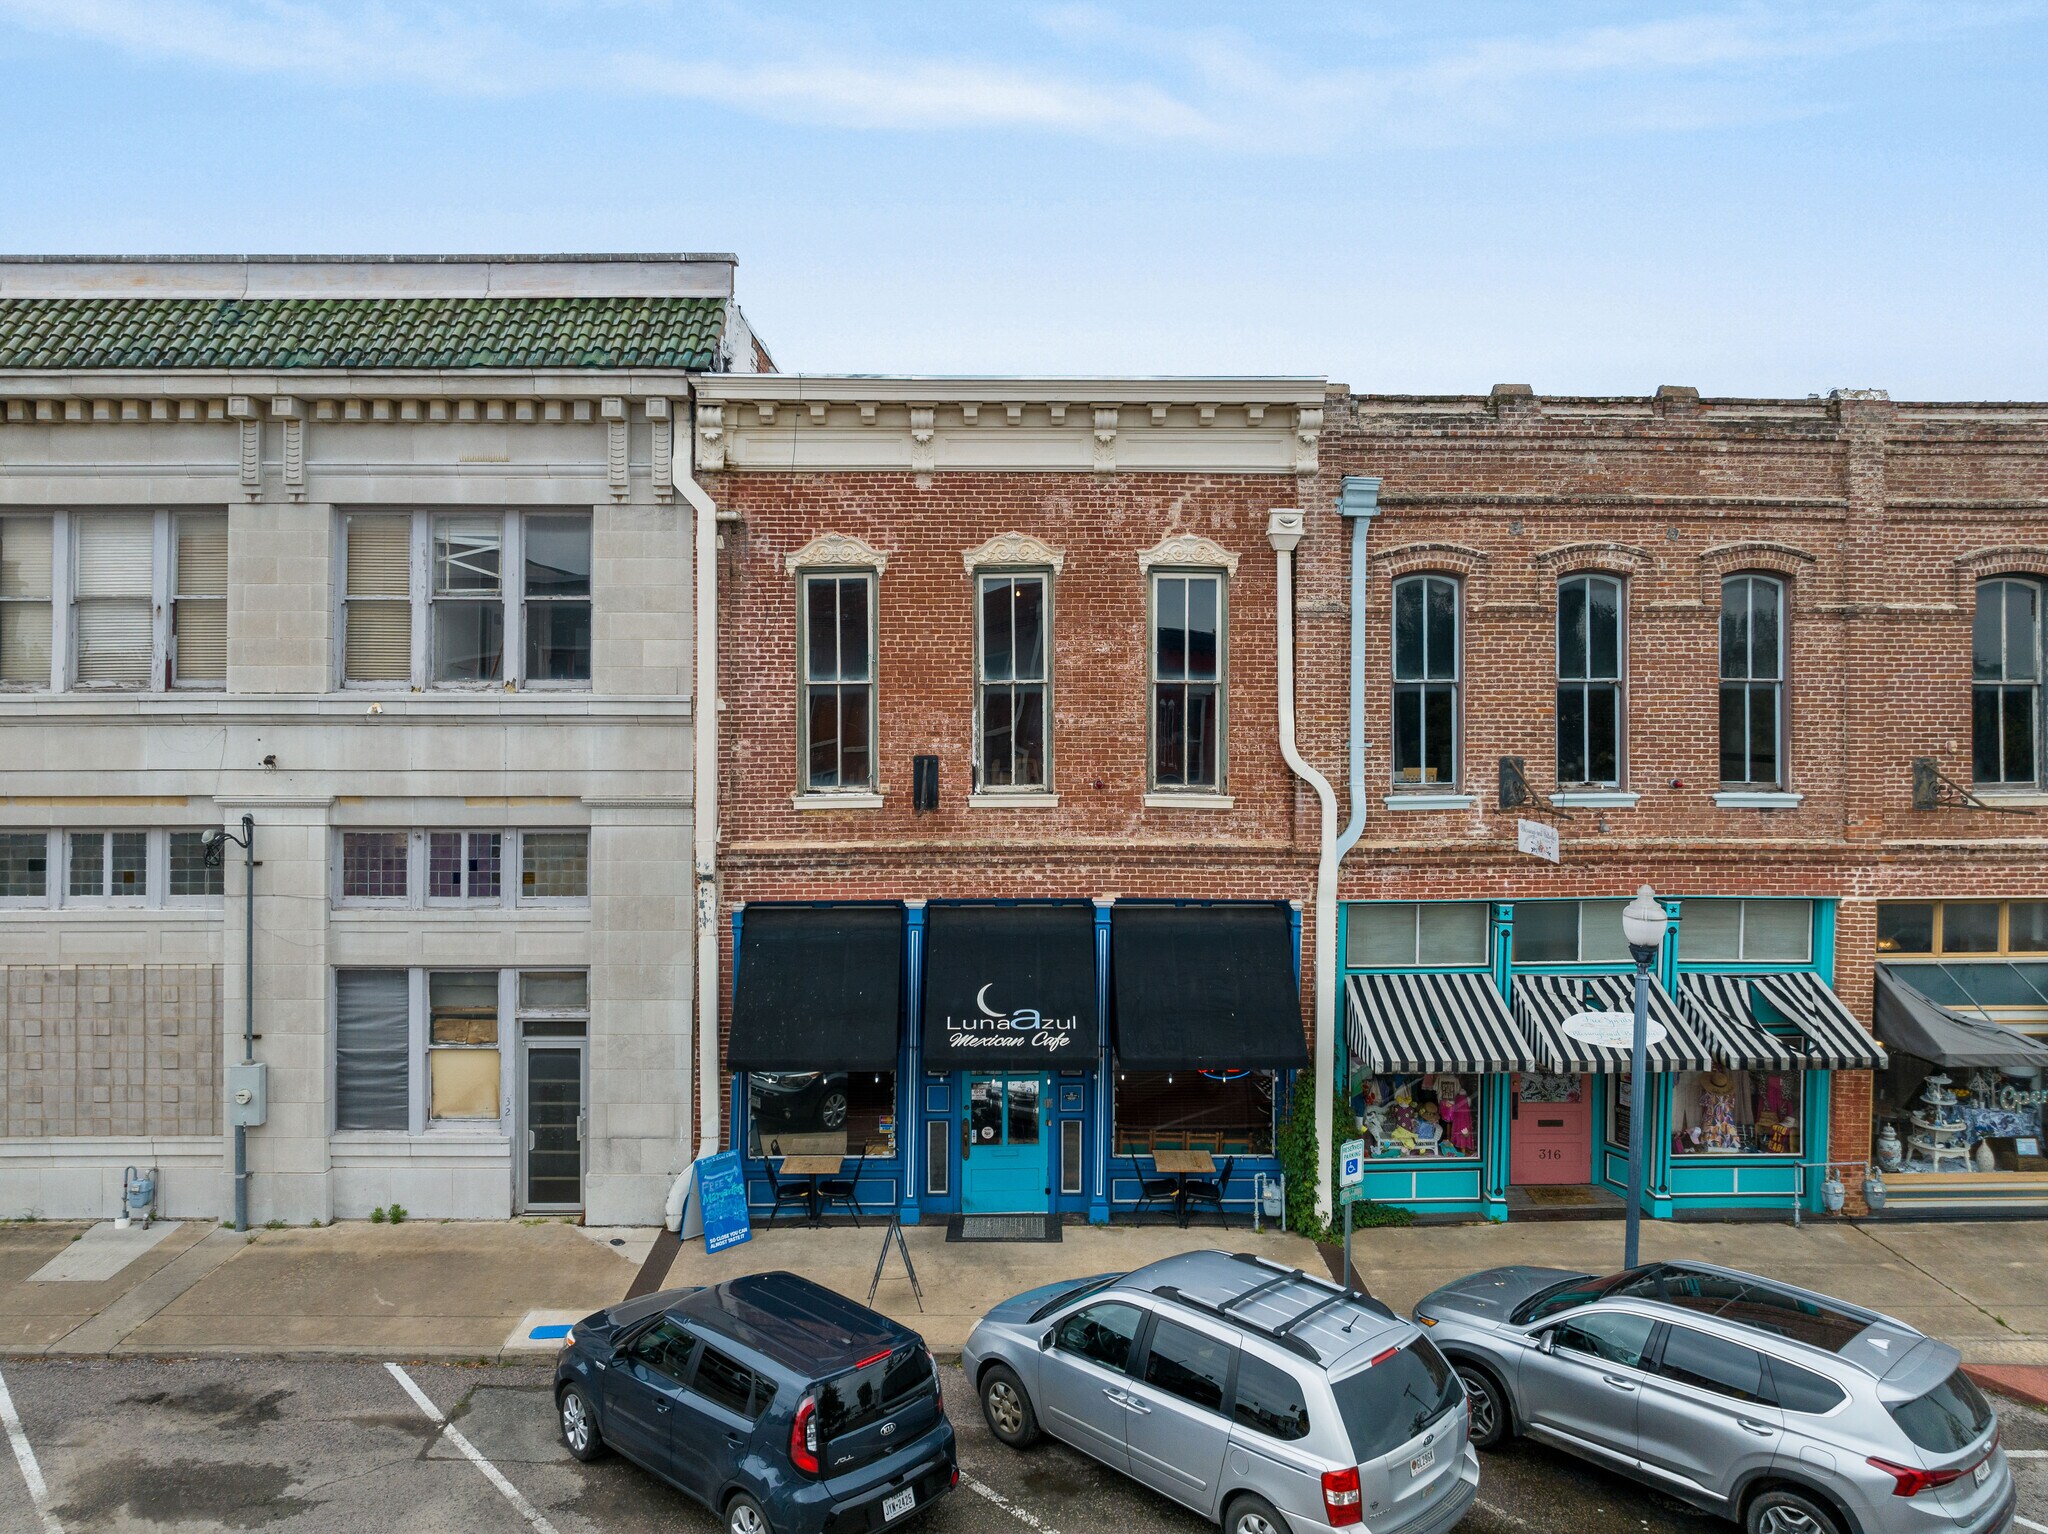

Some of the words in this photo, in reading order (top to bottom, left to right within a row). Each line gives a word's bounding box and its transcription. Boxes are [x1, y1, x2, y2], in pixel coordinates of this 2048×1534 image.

[947, 1016, 1010, 1030] Luna
[949, 1032, 1025, 1048] Mexican
[1031, 1031, 1071, 1052] Cafe
[1342, 1143, 1362, 1153] RESERVED
[1538, 1149, 1562, 1160] 316
[1343, 1151, 1361, 1160] PARKING
[716, 1233, 729, 1241] CLOSE
[730, 1230, 739, 1238] YOU
[738, 1227, 747, 1235] CAN
[710, 1239, 728, 1249] ALMOST
[728, 1234, 740, 1243] TASTE
